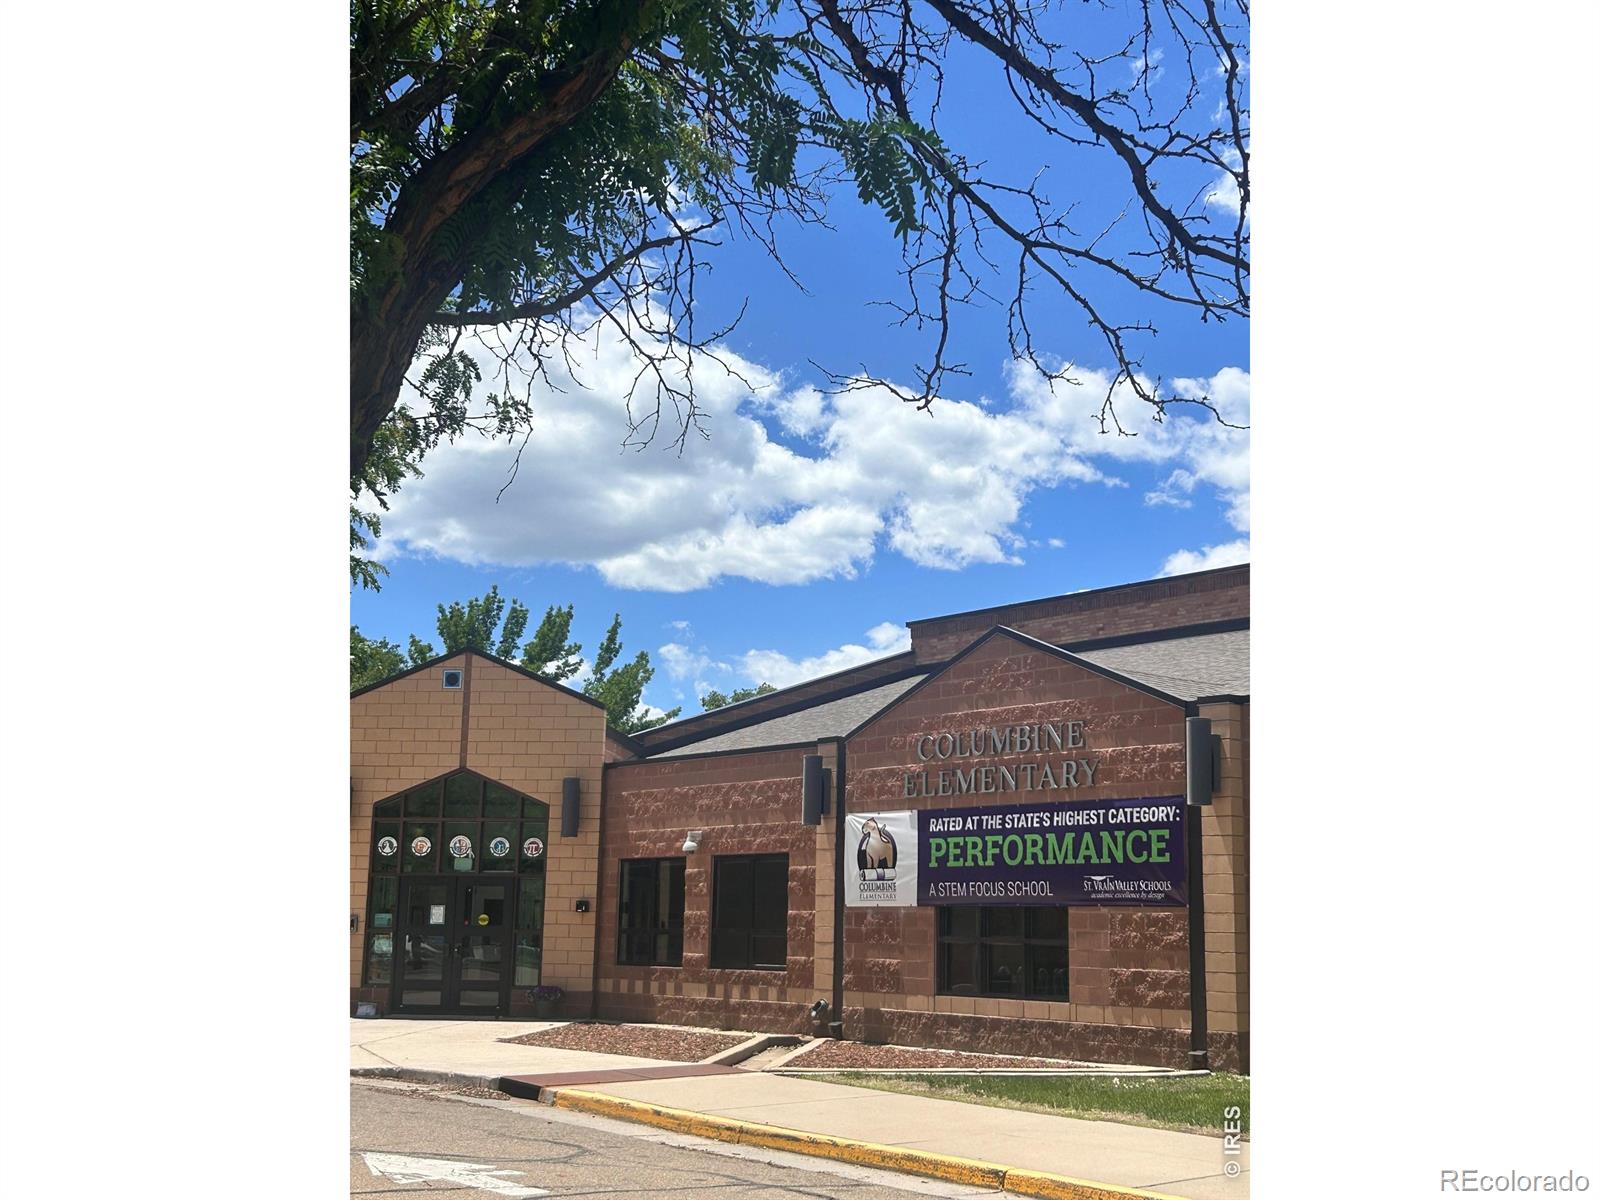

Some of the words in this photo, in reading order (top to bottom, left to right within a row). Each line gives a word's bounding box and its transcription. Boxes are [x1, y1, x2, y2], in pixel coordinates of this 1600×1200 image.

[917, 720, 1085, 761] COLUMBINE
[903, 758, 1100, 798] ELEMENTARY
[929, 817, 963, 832] RATED
[965, 816, 980, 830] AT
[981, 815, 1003, 829] THE
[1005, 811, 1051, 828] STATE'S
[1053, 809, 1105, 826] HIGHEST
[1108, 806, 1180, 824] CATEGORY:
[929, 829, 1170, 868] PERFORMANCE
[859, 882, 897, 892] COLUMBINE
[929, 883, 937, 897] A
[938, 882, 967, 897] STEM
[969, 881, 1005, 897] FOCUS
[1007, 881, 1054, 897] SCHOOL
[1140, 880, 1172, 891] SCHOOLS
[1140, 892, 1147, 900] by
[1148, 892, 1165, 900] design
